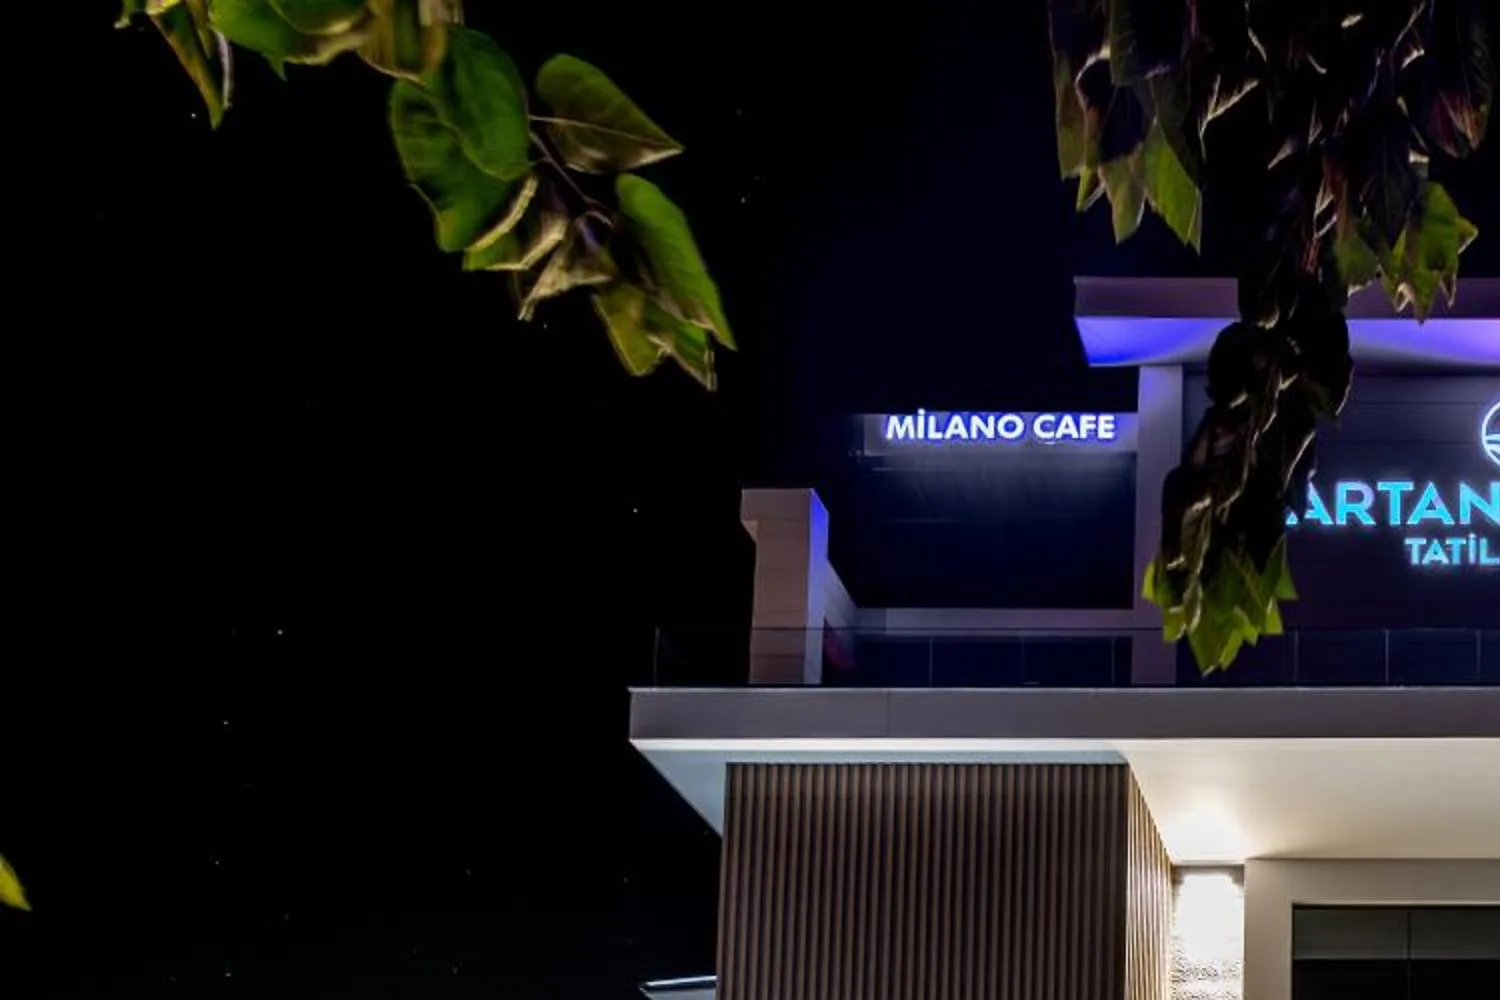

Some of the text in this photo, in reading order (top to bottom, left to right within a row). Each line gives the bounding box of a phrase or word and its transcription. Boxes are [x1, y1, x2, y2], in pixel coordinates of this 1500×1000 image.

[886, 408, 1116, 440] MİLANO CAFE
[1404, 532, 1500, 566] TATİL
